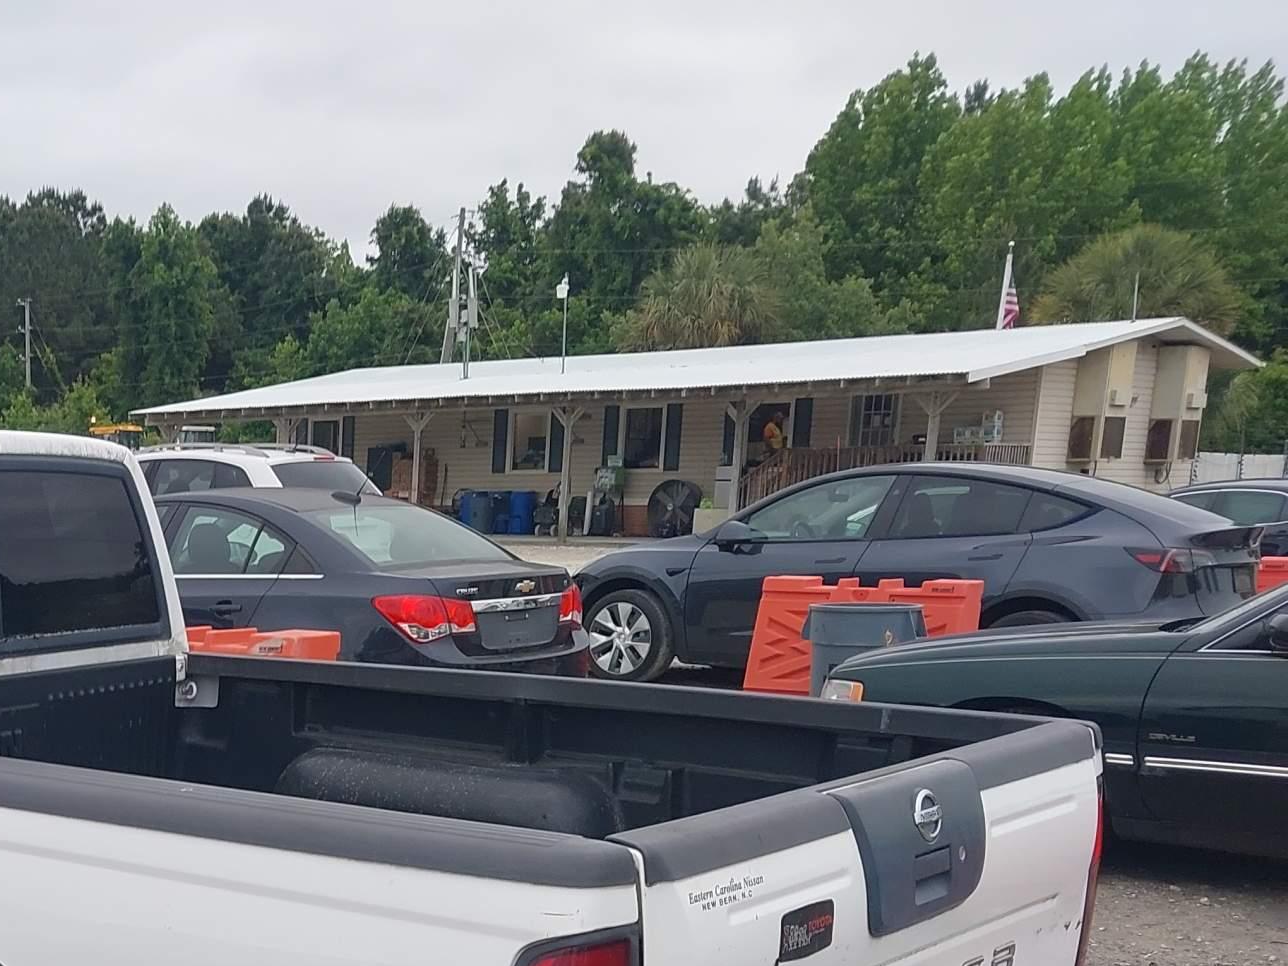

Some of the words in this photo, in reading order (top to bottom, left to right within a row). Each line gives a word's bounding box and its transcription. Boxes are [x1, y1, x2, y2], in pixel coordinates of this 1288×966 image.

[688, 890, 713, 905] Eastern
[715, 878, 742, 897] Carolina
[743, 875, 764, 889] Nissan
[702, 901, 717, 911] NEW
